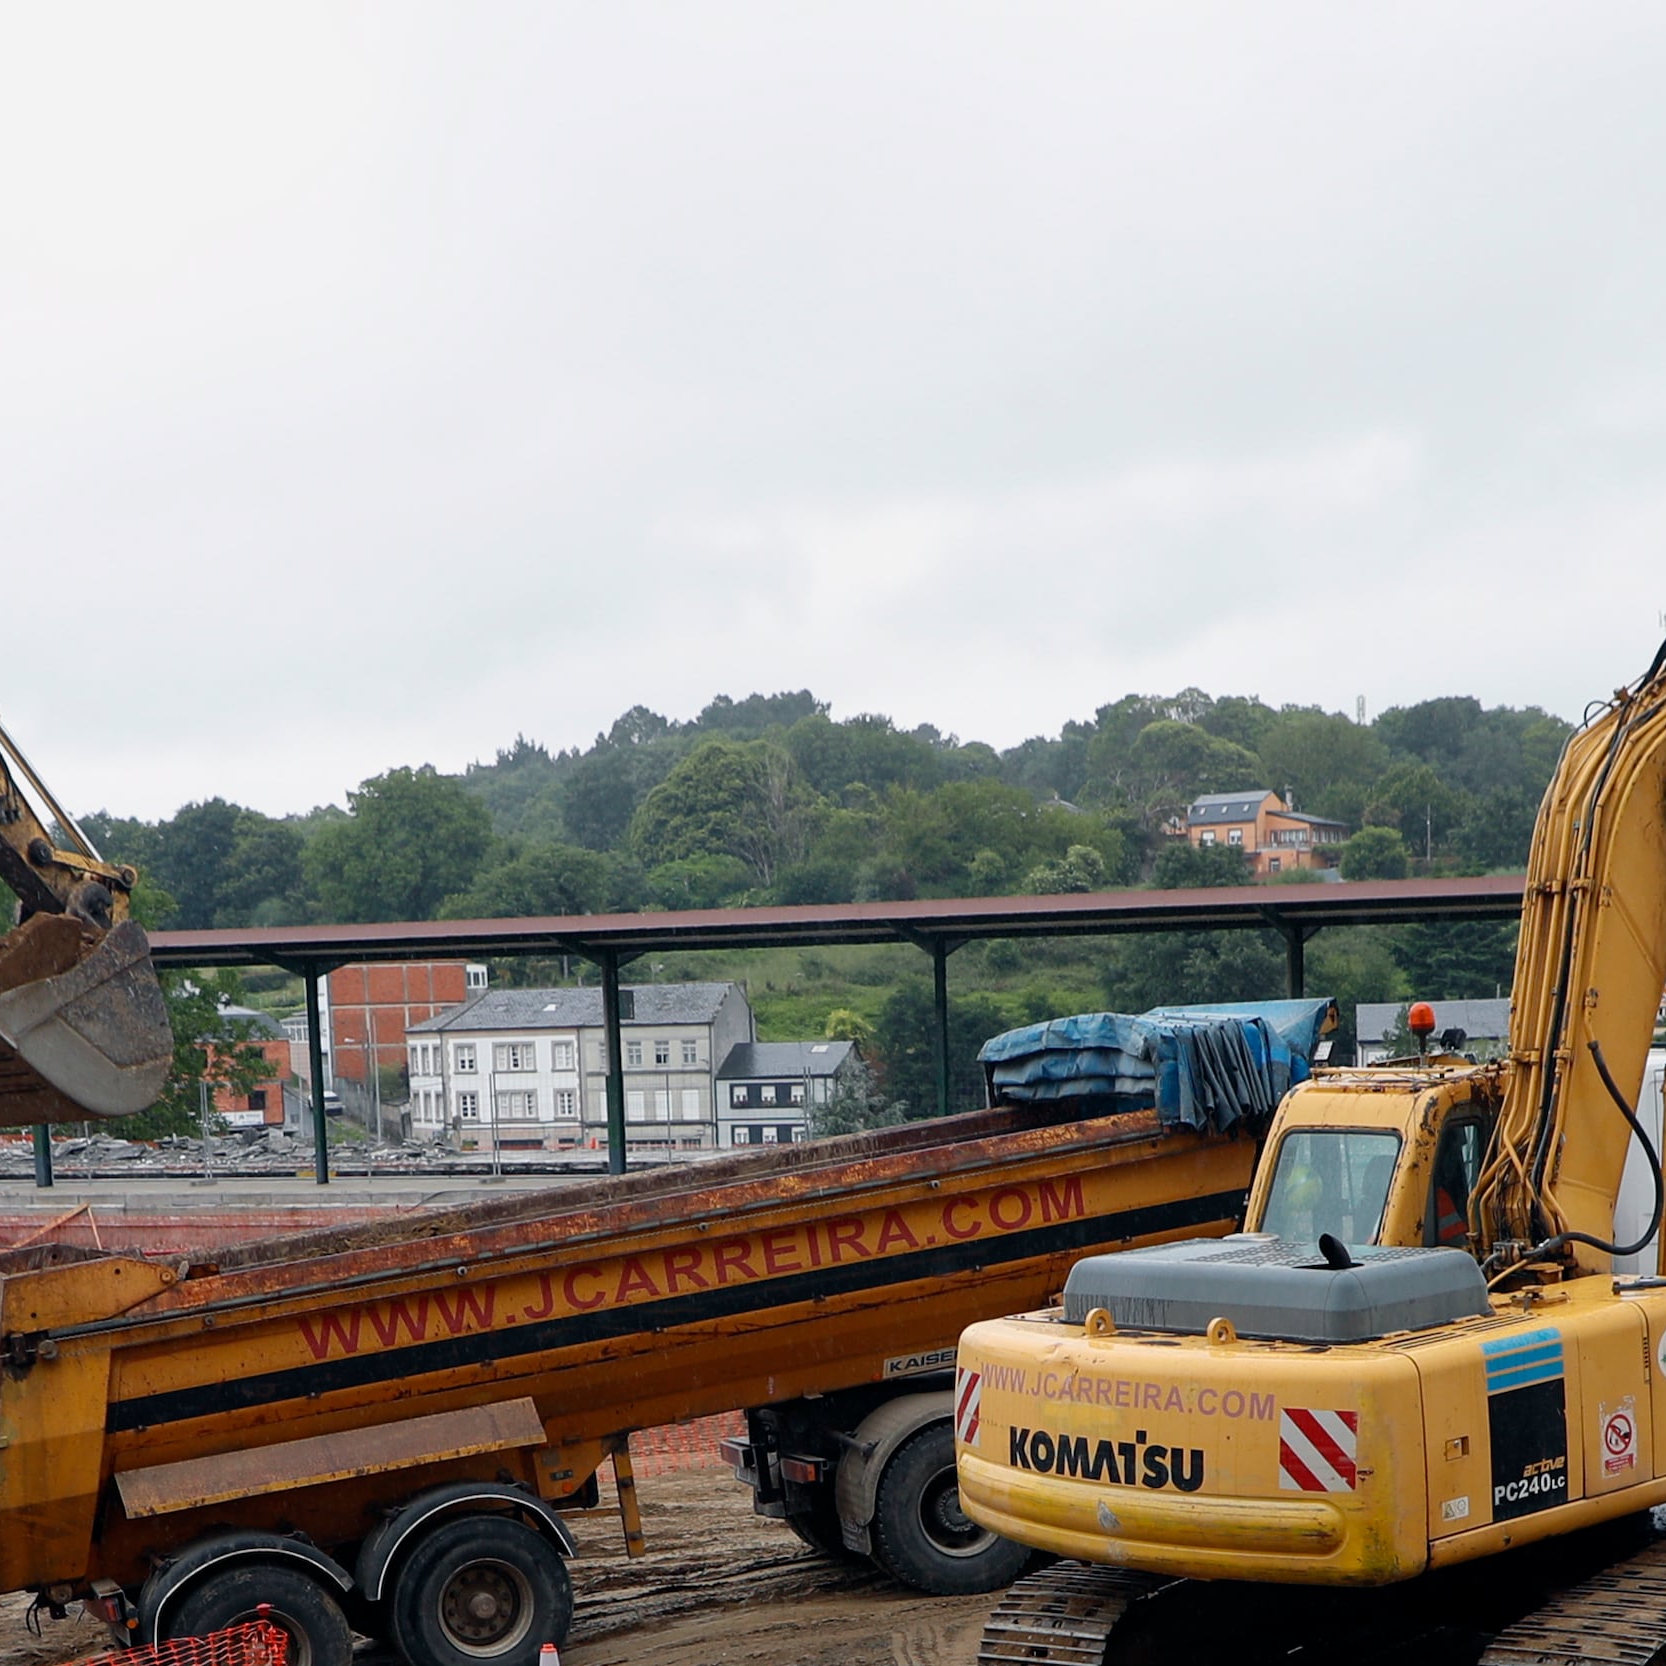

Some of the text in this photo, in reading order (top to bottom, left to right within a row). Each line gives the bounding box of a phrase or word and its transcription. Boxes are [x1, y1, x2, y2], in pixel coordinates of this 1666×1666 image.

[298, 1177, 1085, 1358] WWW.JCARREIRA.COM
[981, 1362, 1275, 1421] WWW.JCARREIRA.COM
[1010, 1426, 1204, 1491] KOMATSU
[1523, 1456, 1565, 1477] active
